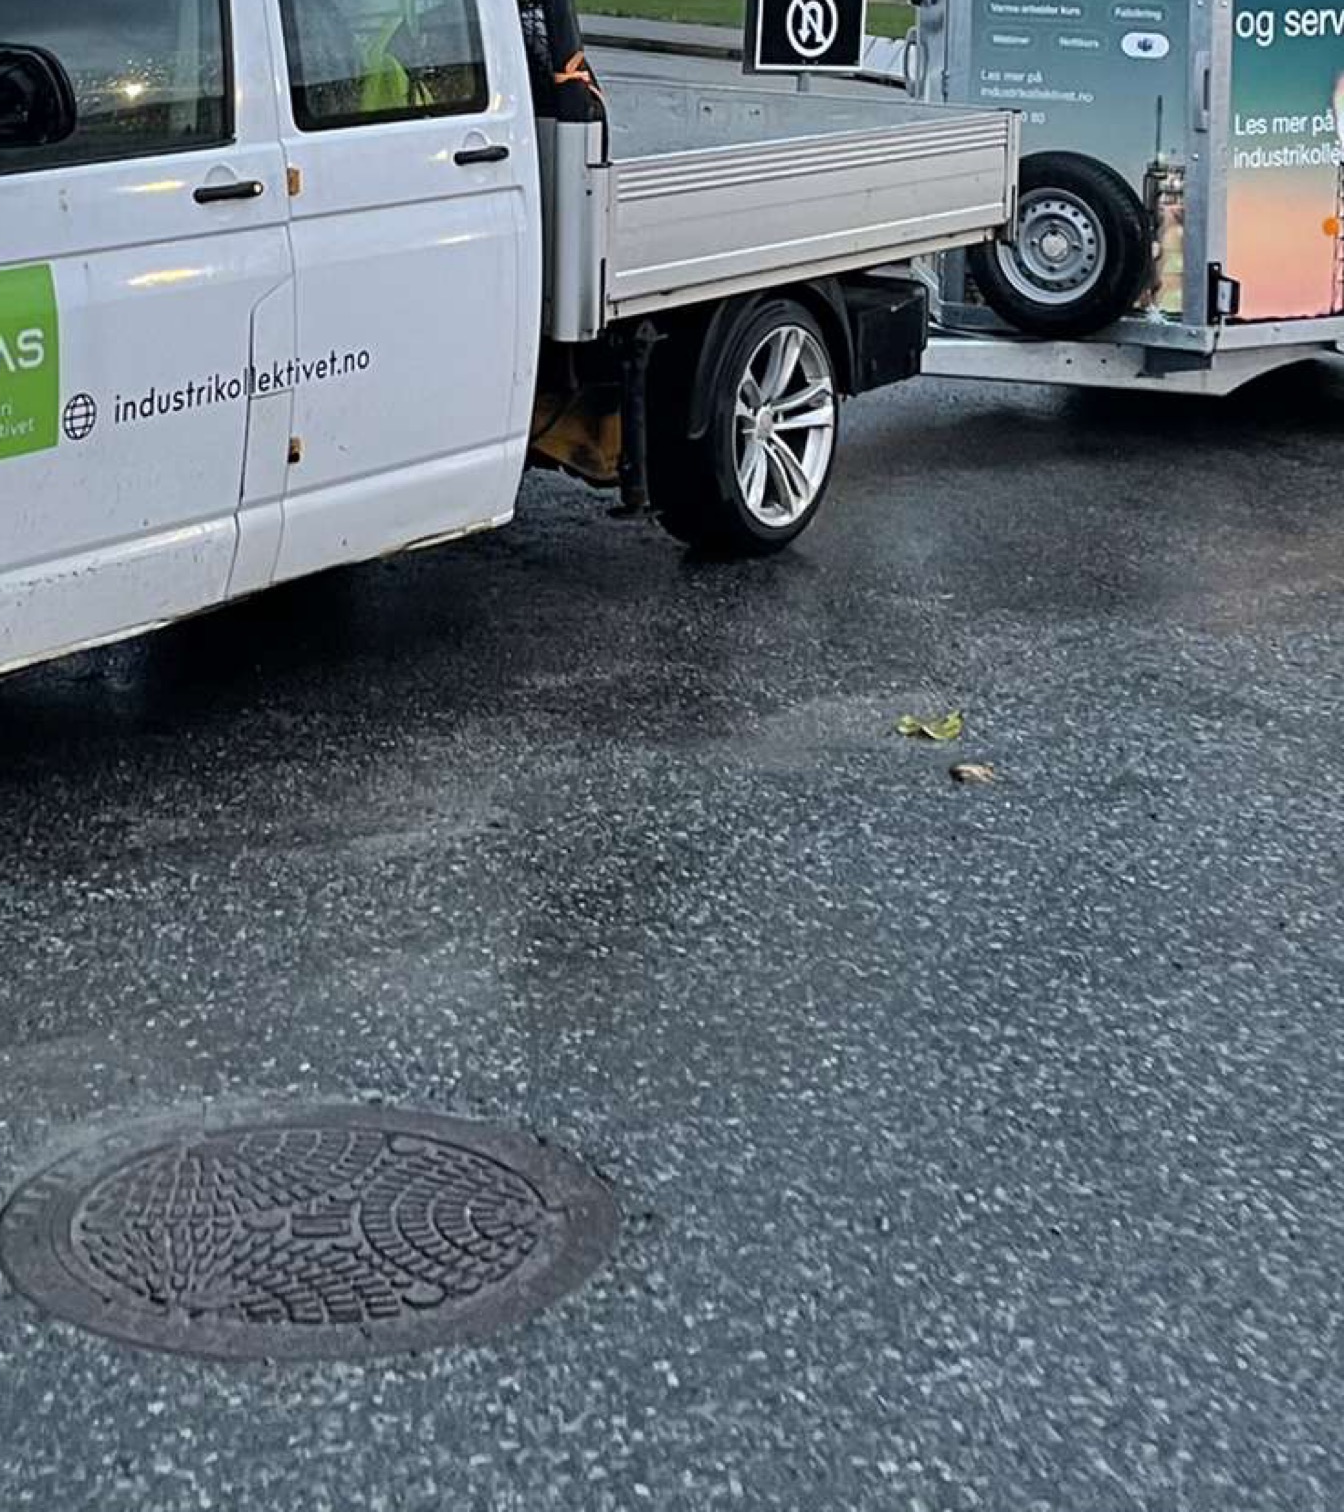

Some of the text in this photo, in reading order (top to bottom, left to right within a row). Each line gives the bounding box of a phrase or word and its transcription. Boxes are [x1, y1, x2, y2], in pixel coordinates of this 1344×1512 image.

[1236, 11, 1275, 46] og
[1234, 108, 1336, 137] Les mer på
[113, 348, 372, 426] industrikollektivet.no
